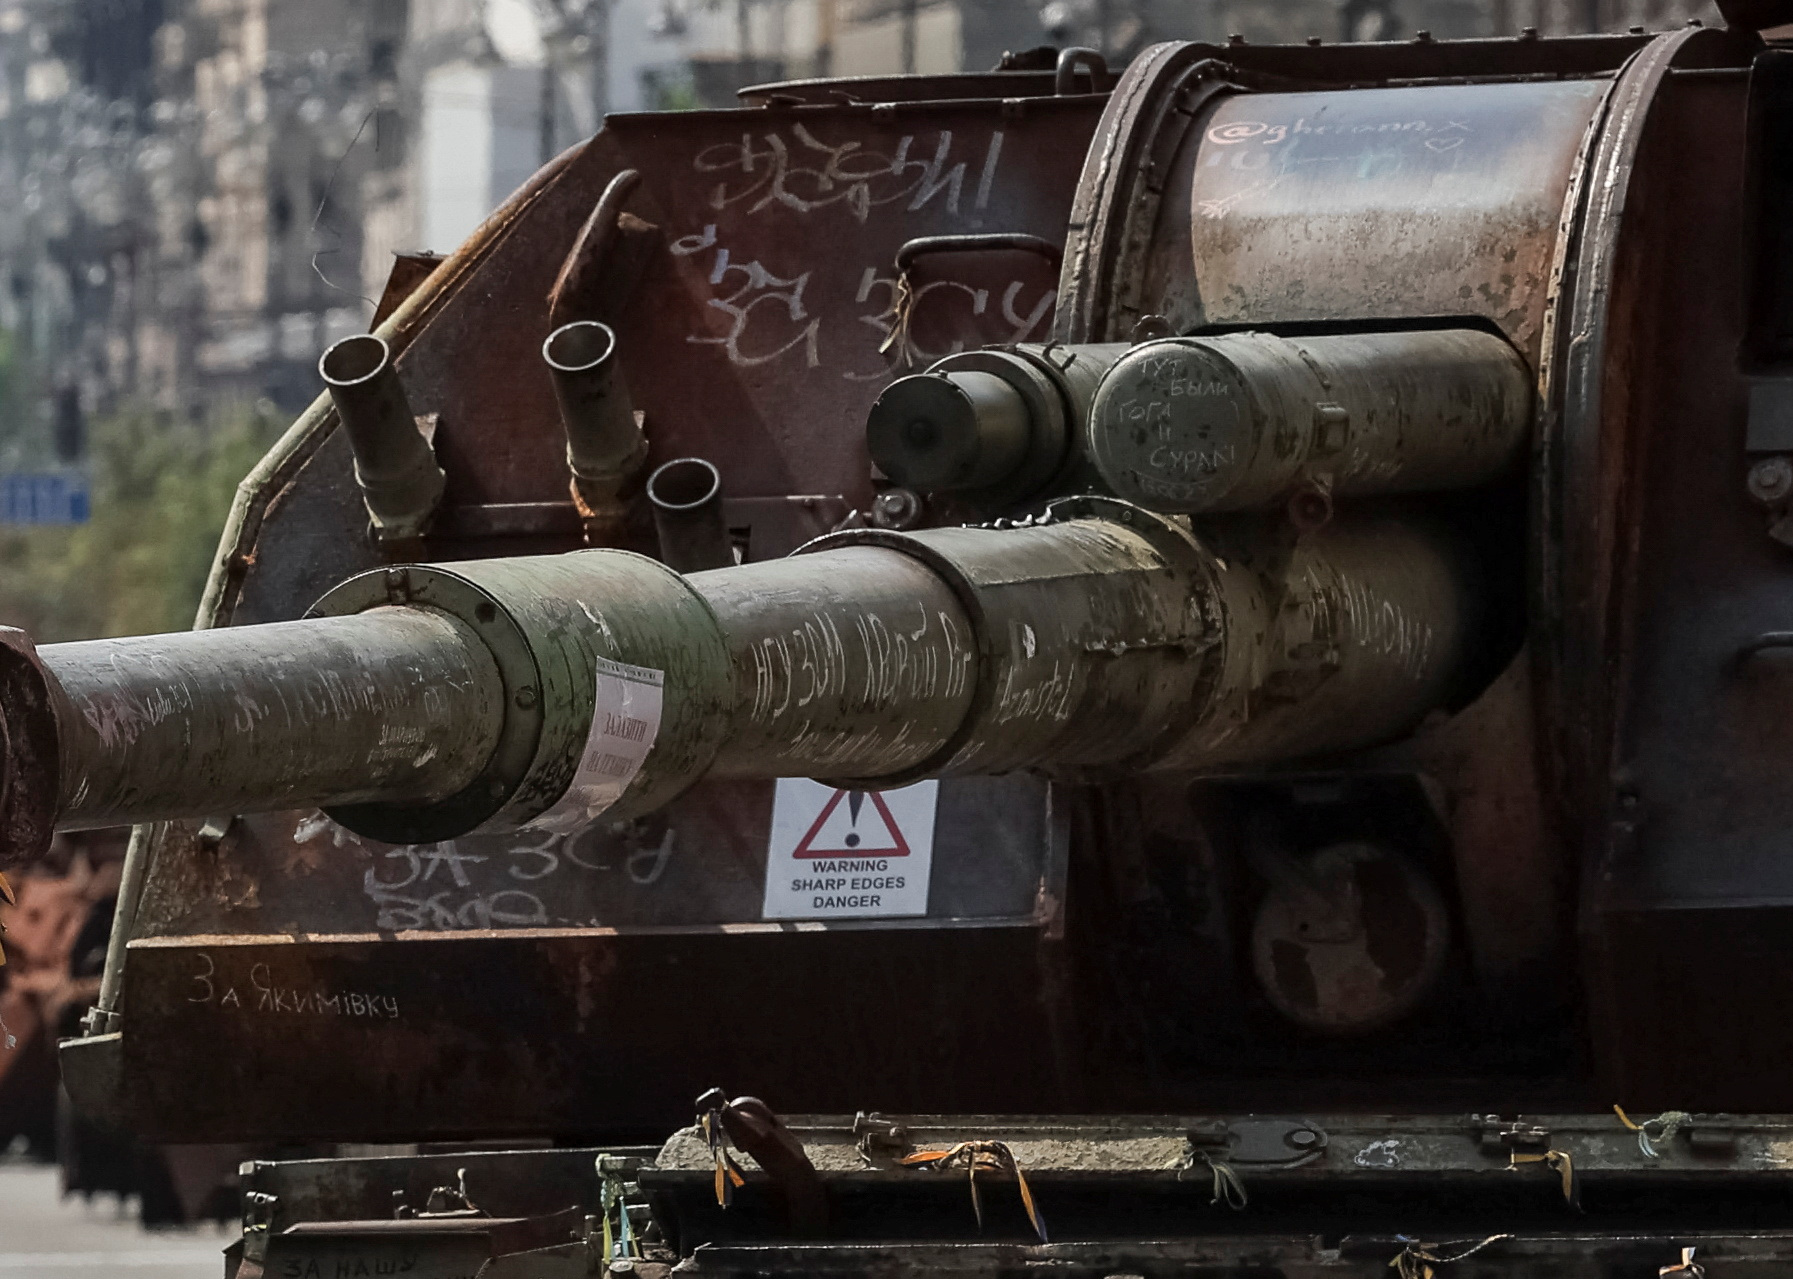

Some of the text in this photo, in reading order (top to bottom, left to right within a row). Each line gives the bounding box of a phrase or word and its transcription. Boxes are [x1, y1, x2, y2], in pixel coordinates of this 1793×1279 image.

[1138, 357, 1182, 376] ТУТ
[1171, 378, 1228, 396] БЫЛИ
[1119, 398, 1171, 423] ГОГА
[812, 859, 889, 873] WARNING
[790, 876, 906, 892] SHARP EDGES
[812, 894, 881, 909] DANGER
[283, 1251, 419, 1279] ЗА НАШУ
